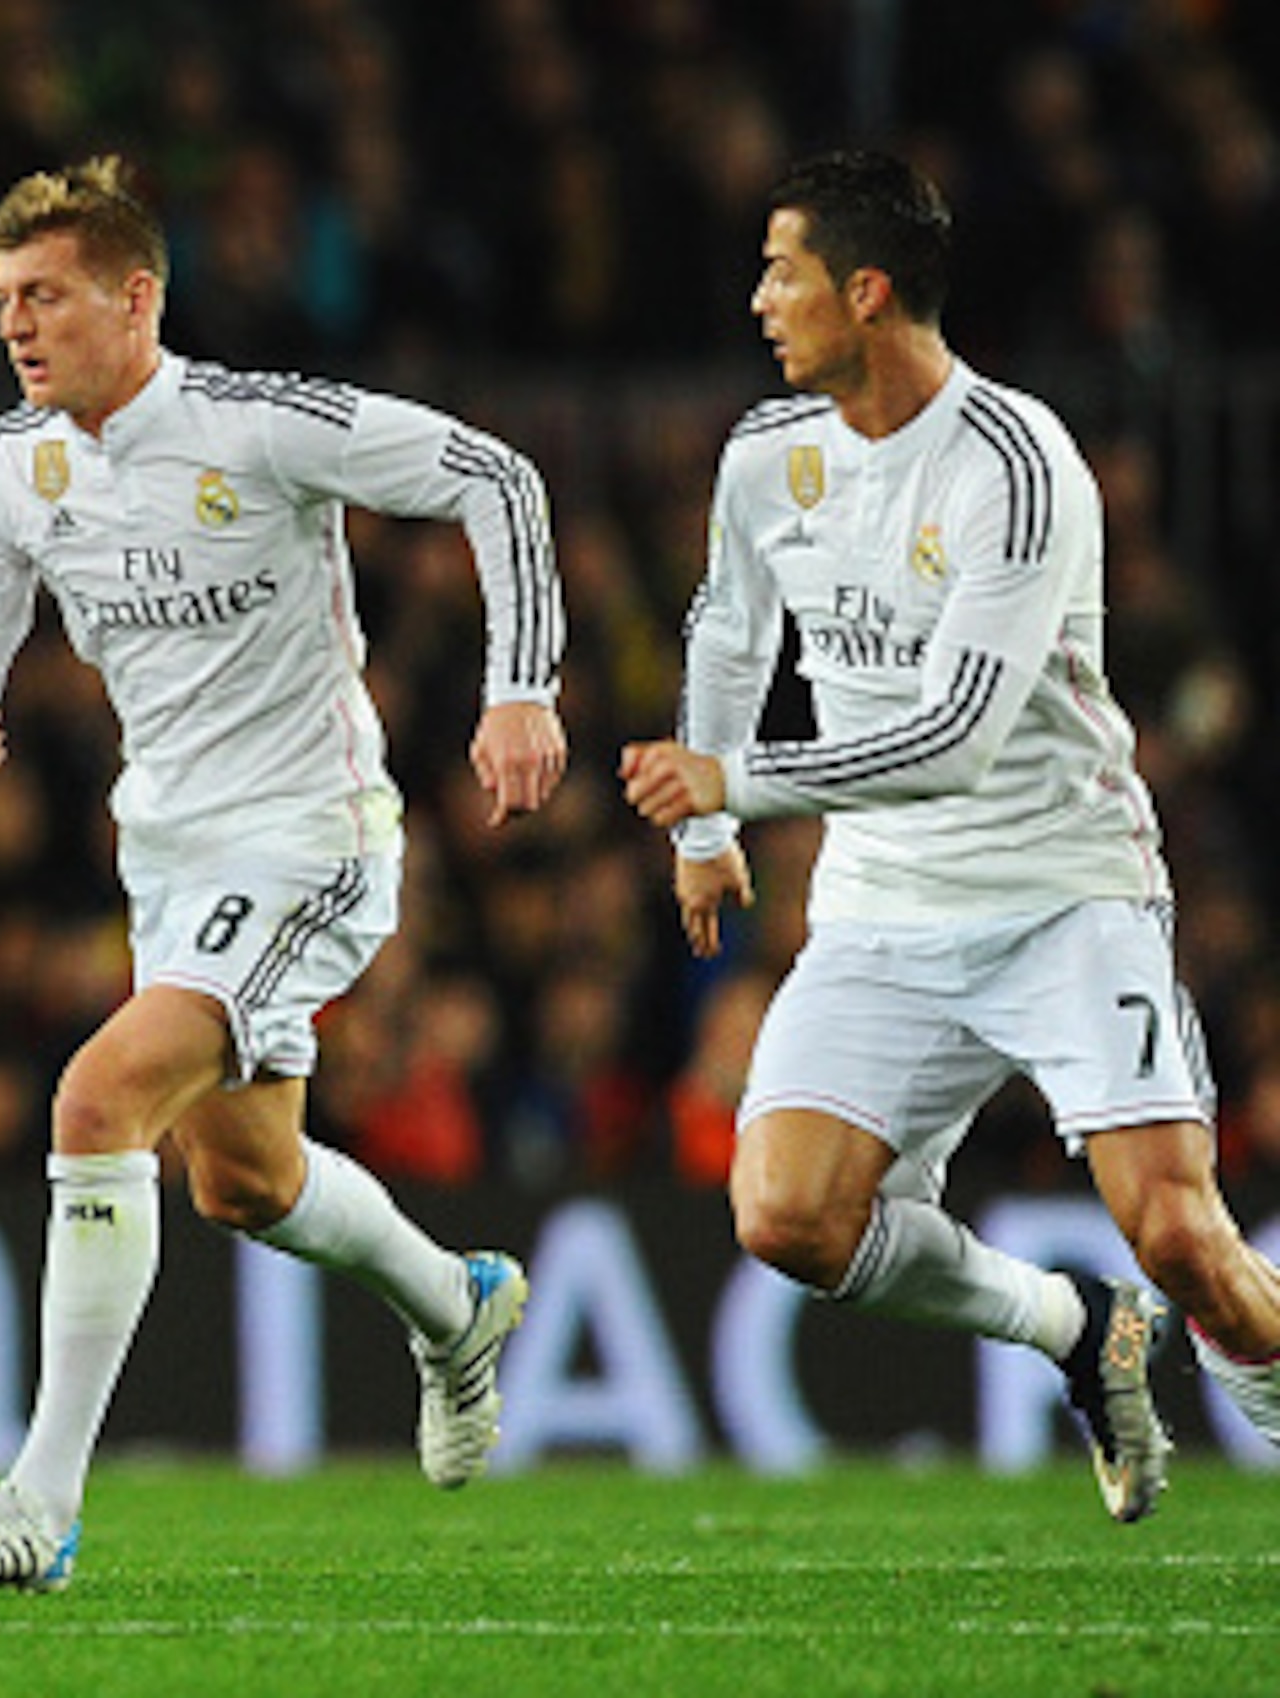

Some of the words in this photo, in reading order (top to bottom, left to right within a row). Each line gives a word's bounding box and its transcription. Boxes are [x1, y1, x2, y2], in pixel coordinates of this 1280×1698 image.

[123, 547, 184, 583] Fly
[195, 893, 256, 955] 8
[1116, 992, 1161, 1081] 7
